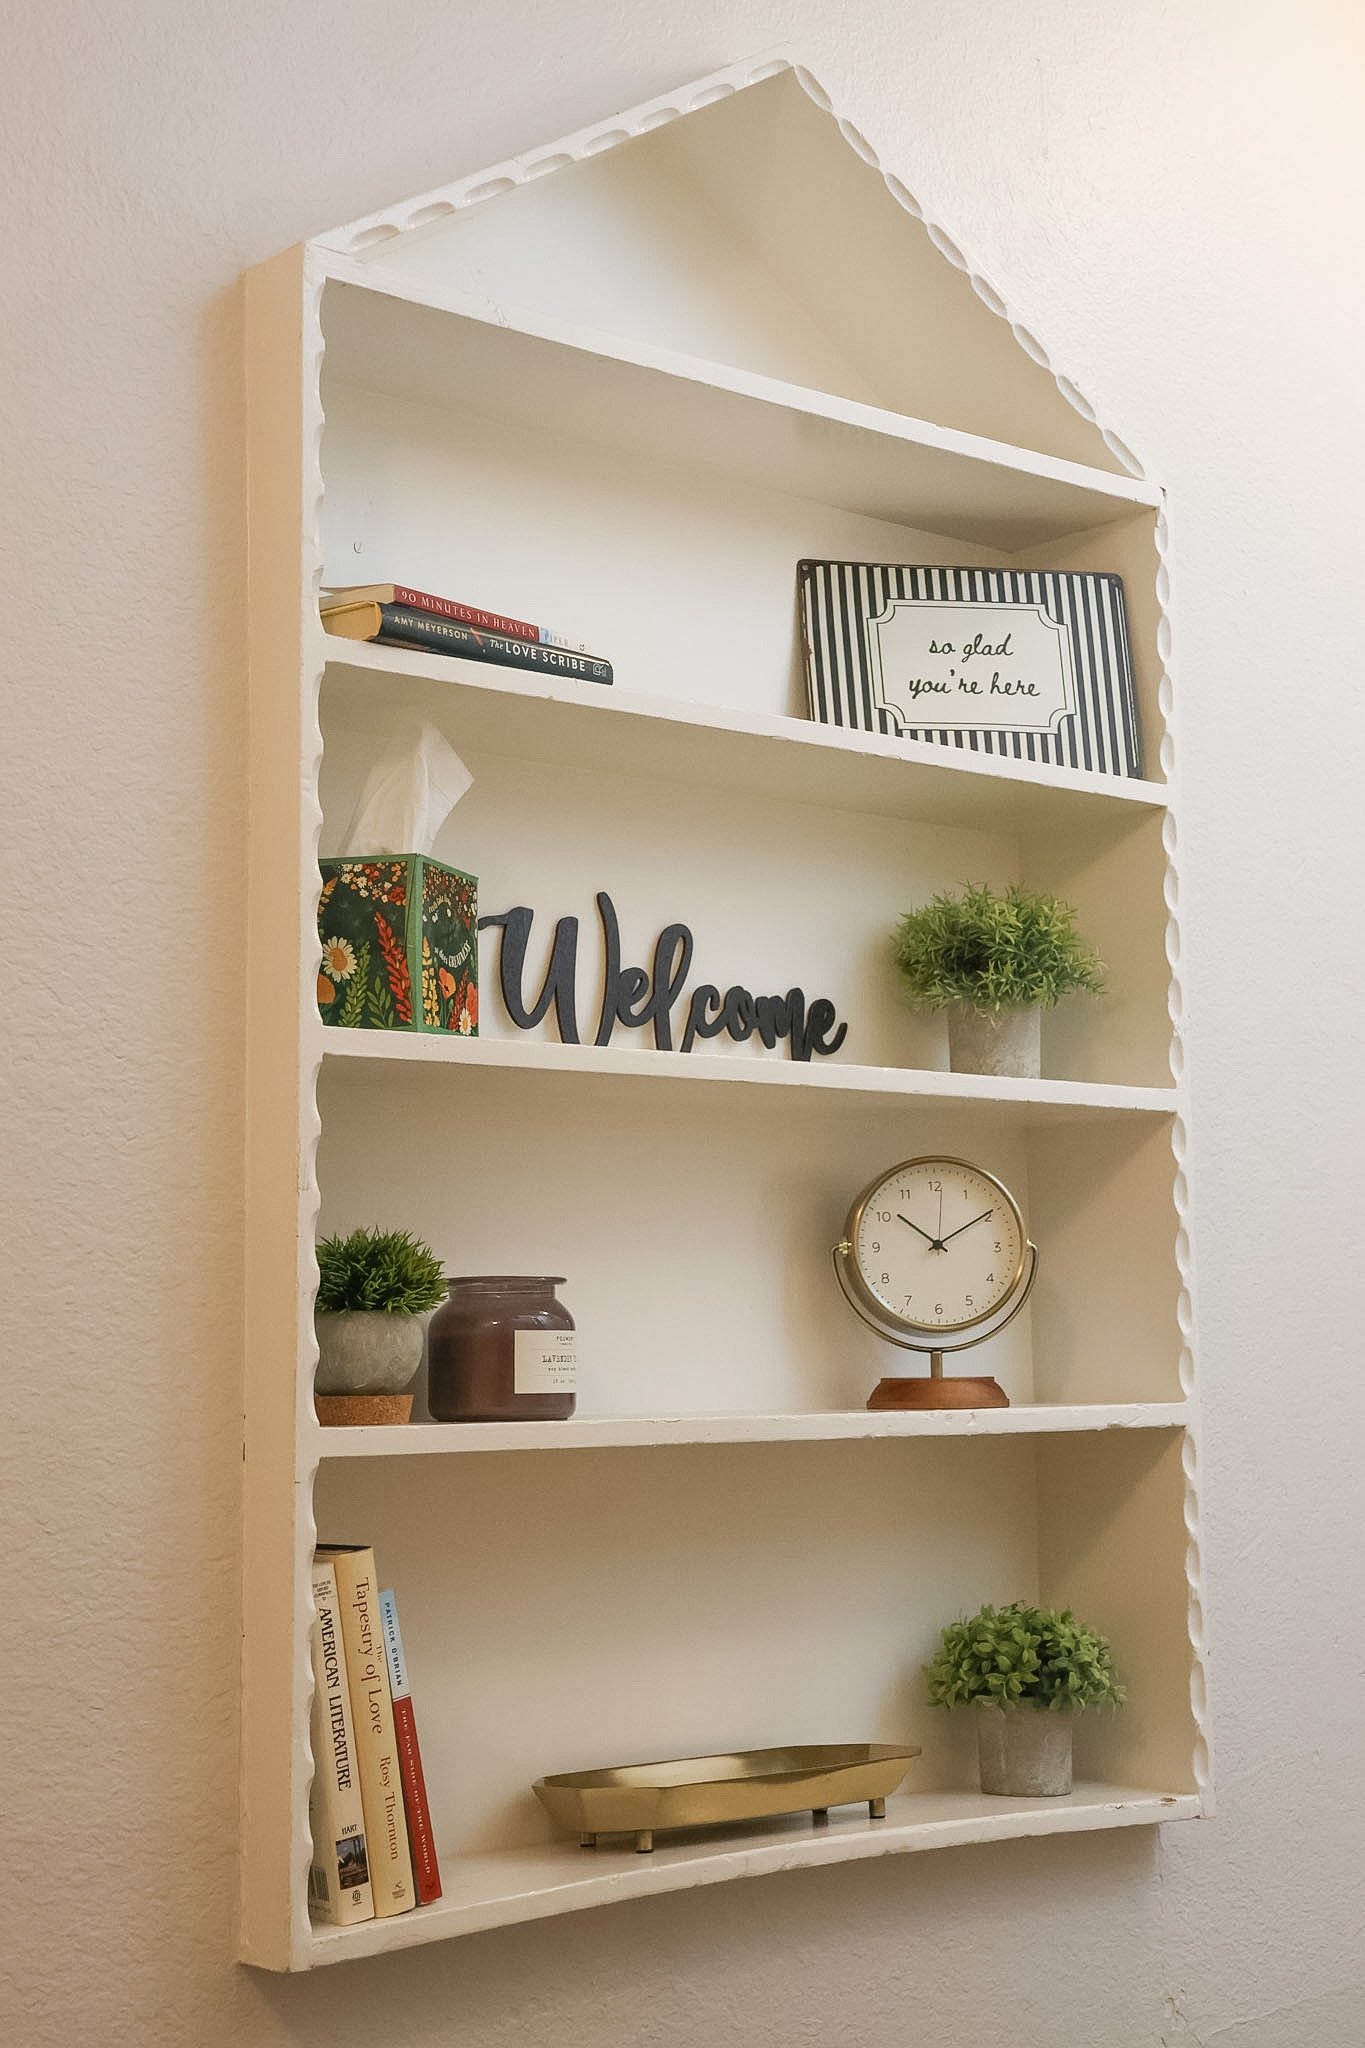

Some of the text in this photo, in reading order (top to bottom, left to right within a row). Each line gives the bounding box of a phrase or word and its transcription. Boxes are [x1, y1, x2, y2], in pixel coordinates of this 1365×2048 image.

[400, 591, 417, 603] 90
[421, 596, 473, 620] MINUTES
[477, 612, 489, 624] IN
[493, 617, 537, 639] HEAVEN
[394, 615, 468, 641] AMY MEYERSON
[490, 639, 504, 651] The
[505, 641, 537, 660] LOVE
[543, 652, 586, 672] SCRIBE
[929, 633, 1014, 663] so glad
[909, 669, 1040, 699] you're here
[478, 891, 848, 1062] Welcome
[900, 1189, 911, 1199] 11
[928, 1181, 942, 1193] 12
[963, 1189, 968, 1199] 1
[876, 1211, 892, 1223] 10
[871, 1241, 881, 1253] 9
[994, 1241, 1002, 1253] 3
[881, 1273, 890, 1284] 8
[986, 1273, 994, 1282] 4
[904, 1295, 912, 1306] 7
[935, 1304, 943, 1314] 6
[965, 1295, 973, 1306] 5
[319, 1607, 340, 1689] AMERICAN
[384, 1602, 404, 1686] PATRICK O'BRIAN
[352, 1576, 383, 1735] Tapestry of Love
[329, 1695, 352, 1791] LITERATURE
[378, 1756, 399, 1861] Rosy Thornton
